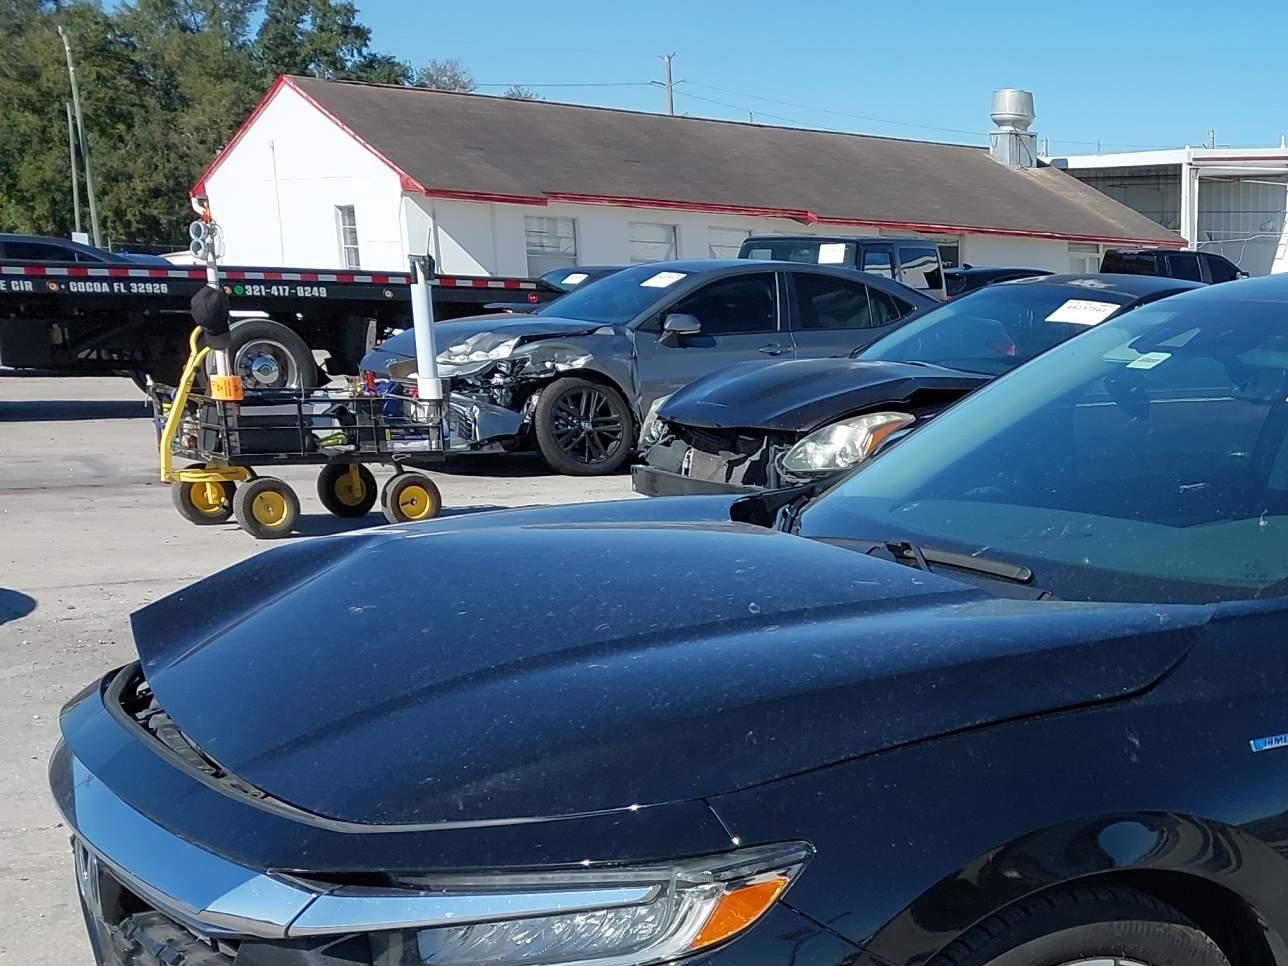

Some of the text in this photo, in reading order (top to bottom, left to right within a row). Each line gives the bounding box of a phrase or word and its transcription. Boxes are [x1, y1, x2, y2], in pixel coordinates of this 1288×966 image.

[10, 280, 33, 291] CIR
[69, 281, 110, 293] COCOA
[113, 282, 128, 294] FL
[129, 282, 168, 294] 32926
